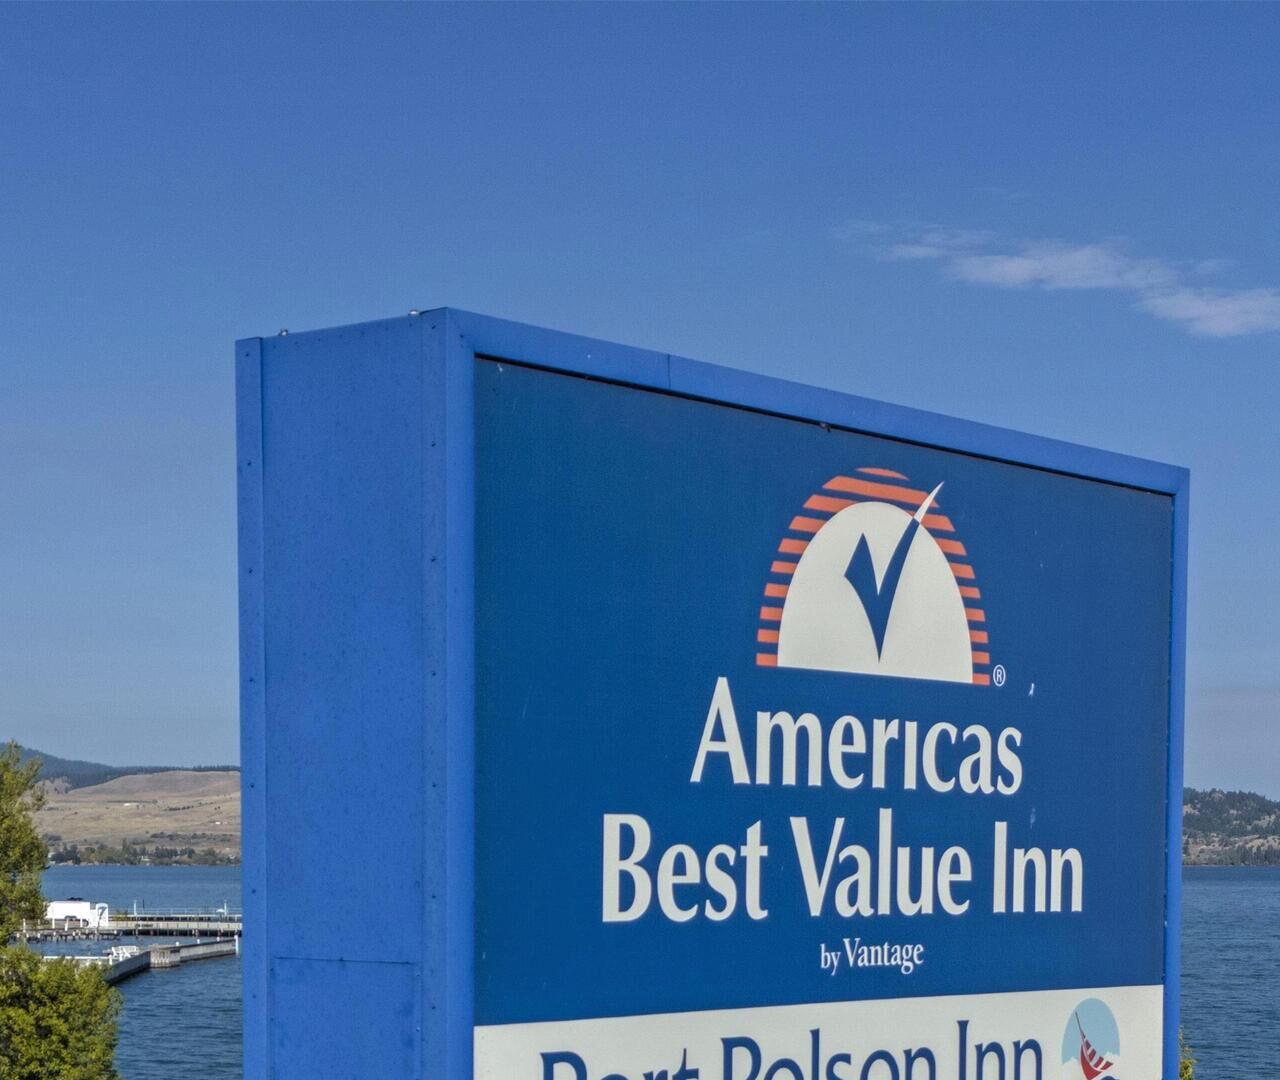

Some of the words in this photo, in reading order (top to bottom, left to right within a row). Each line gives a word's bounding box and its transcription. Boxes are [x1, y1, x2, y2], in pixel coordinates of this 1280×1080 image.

[689, 676, 1023, 796] Americas
[602, 813, 769, 923] Best
[789, 807, 973, 918] Value
[992, 821, 1083, 914] Inn
[820, 943, 841, 976] by
[842, 937, 925, 975] Vantage
